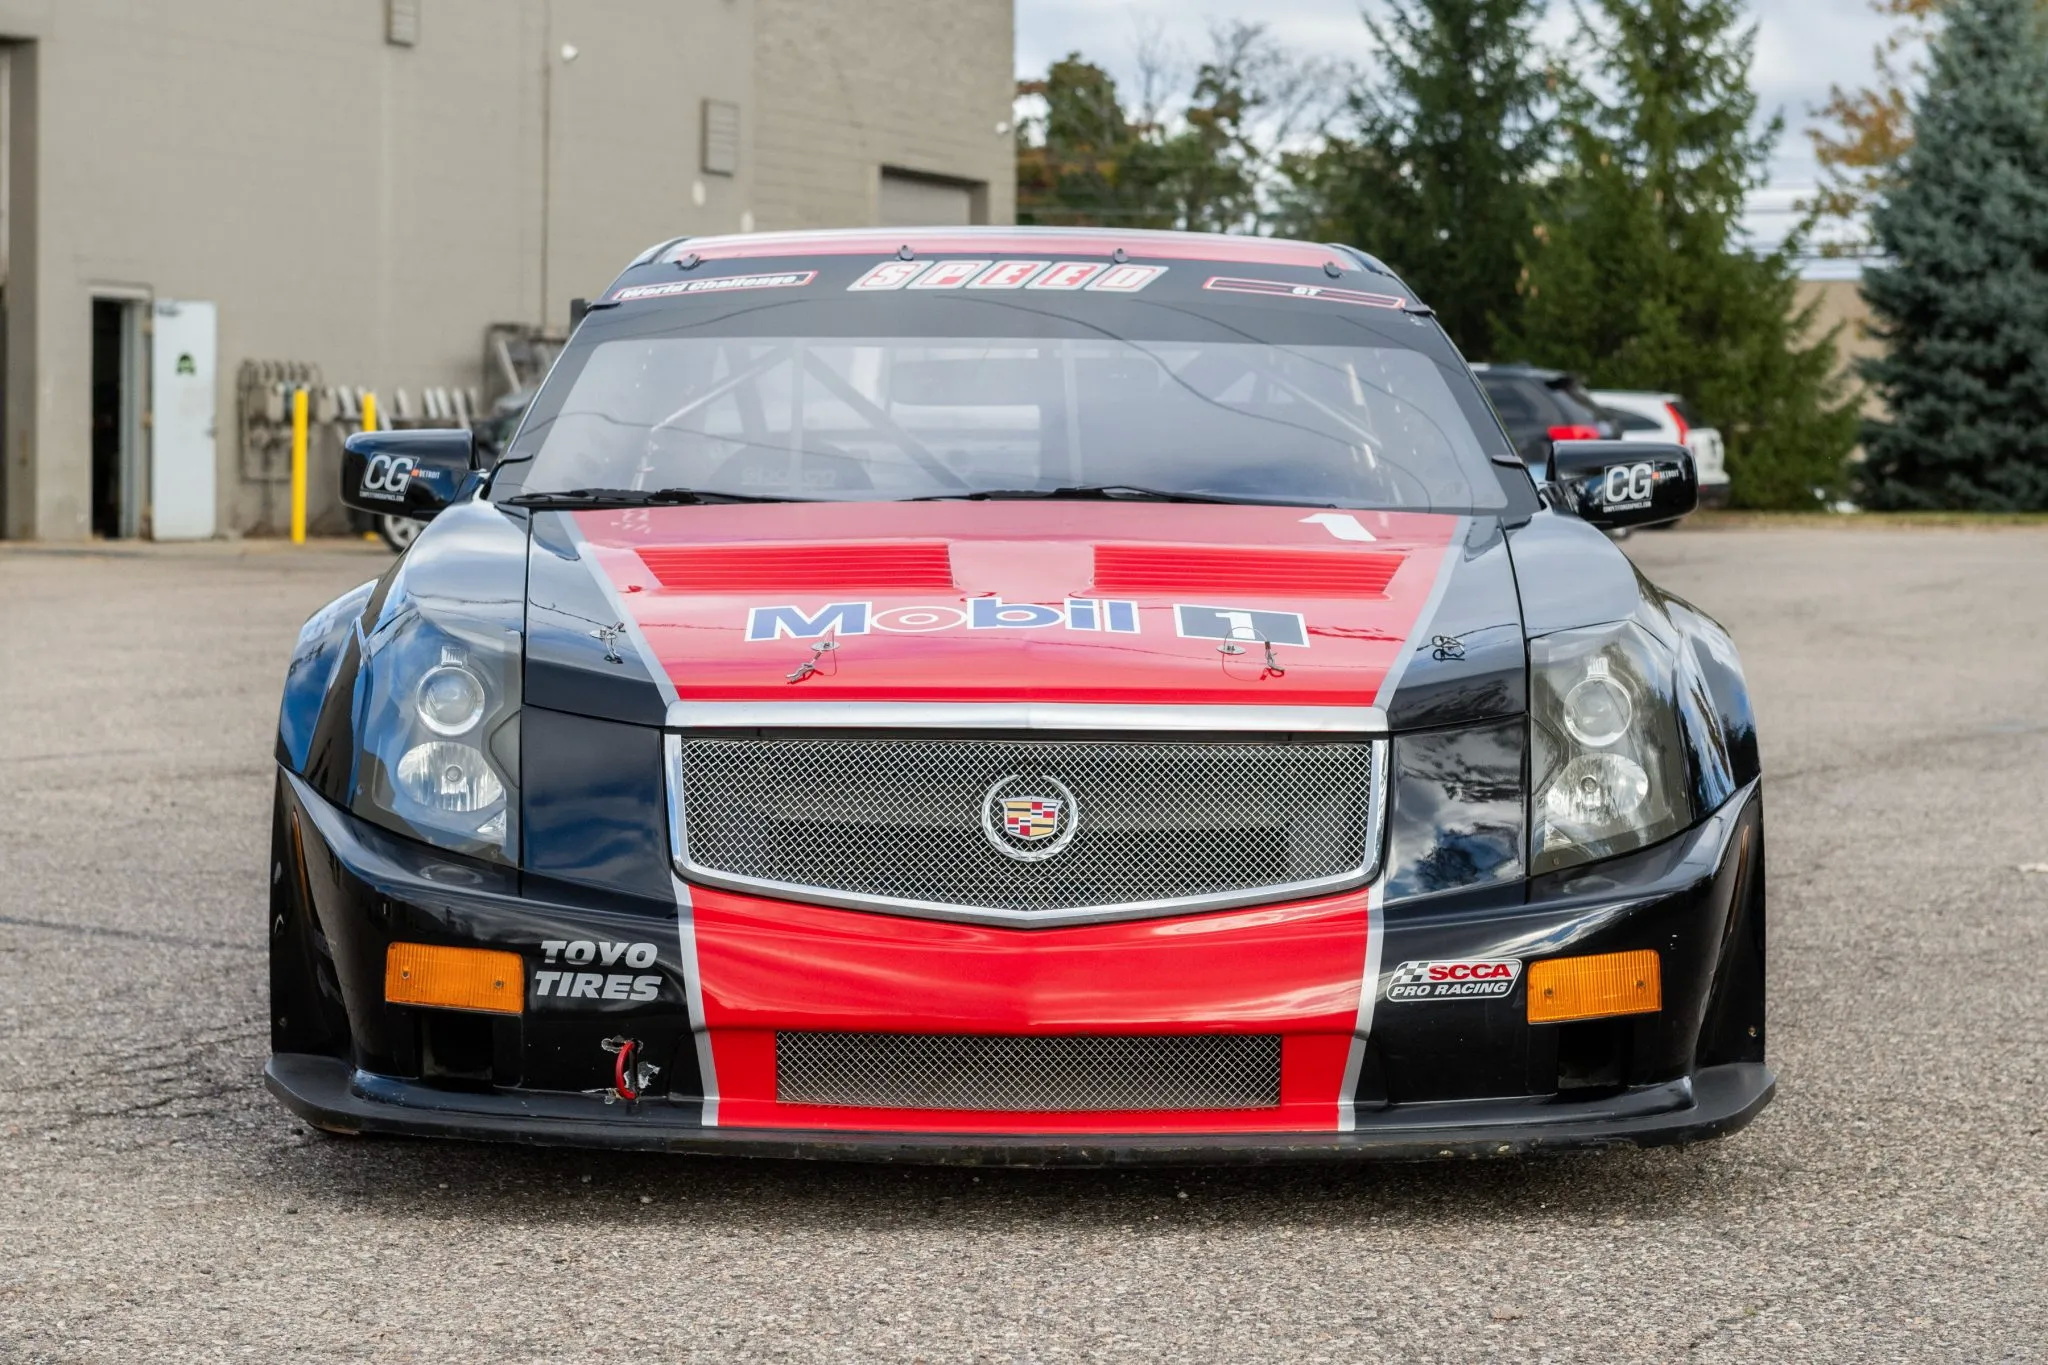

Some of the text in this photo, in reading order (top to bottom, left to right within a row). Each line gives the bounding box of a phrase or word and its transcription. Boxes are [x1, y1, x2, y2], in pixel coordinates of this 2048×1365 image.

[621, 275, 798, 299] World Challenge
[849, 260, 1167, 292] SPEED
[1292, 286, 1322, 296] GT
[364, 455, 414, 492] CG
[1606, 463, 1652, 502] CG
[1298, 513, 1377, 542] 1
[745, 598, 1141, 642] Mobil
[541, 940, 659, 969] TOYO
[535, 971, 663, 1002] TIRES
[1428, 963, 1513, 981] SCCA
[1391, 982, 1508, 997] PRO RACING
